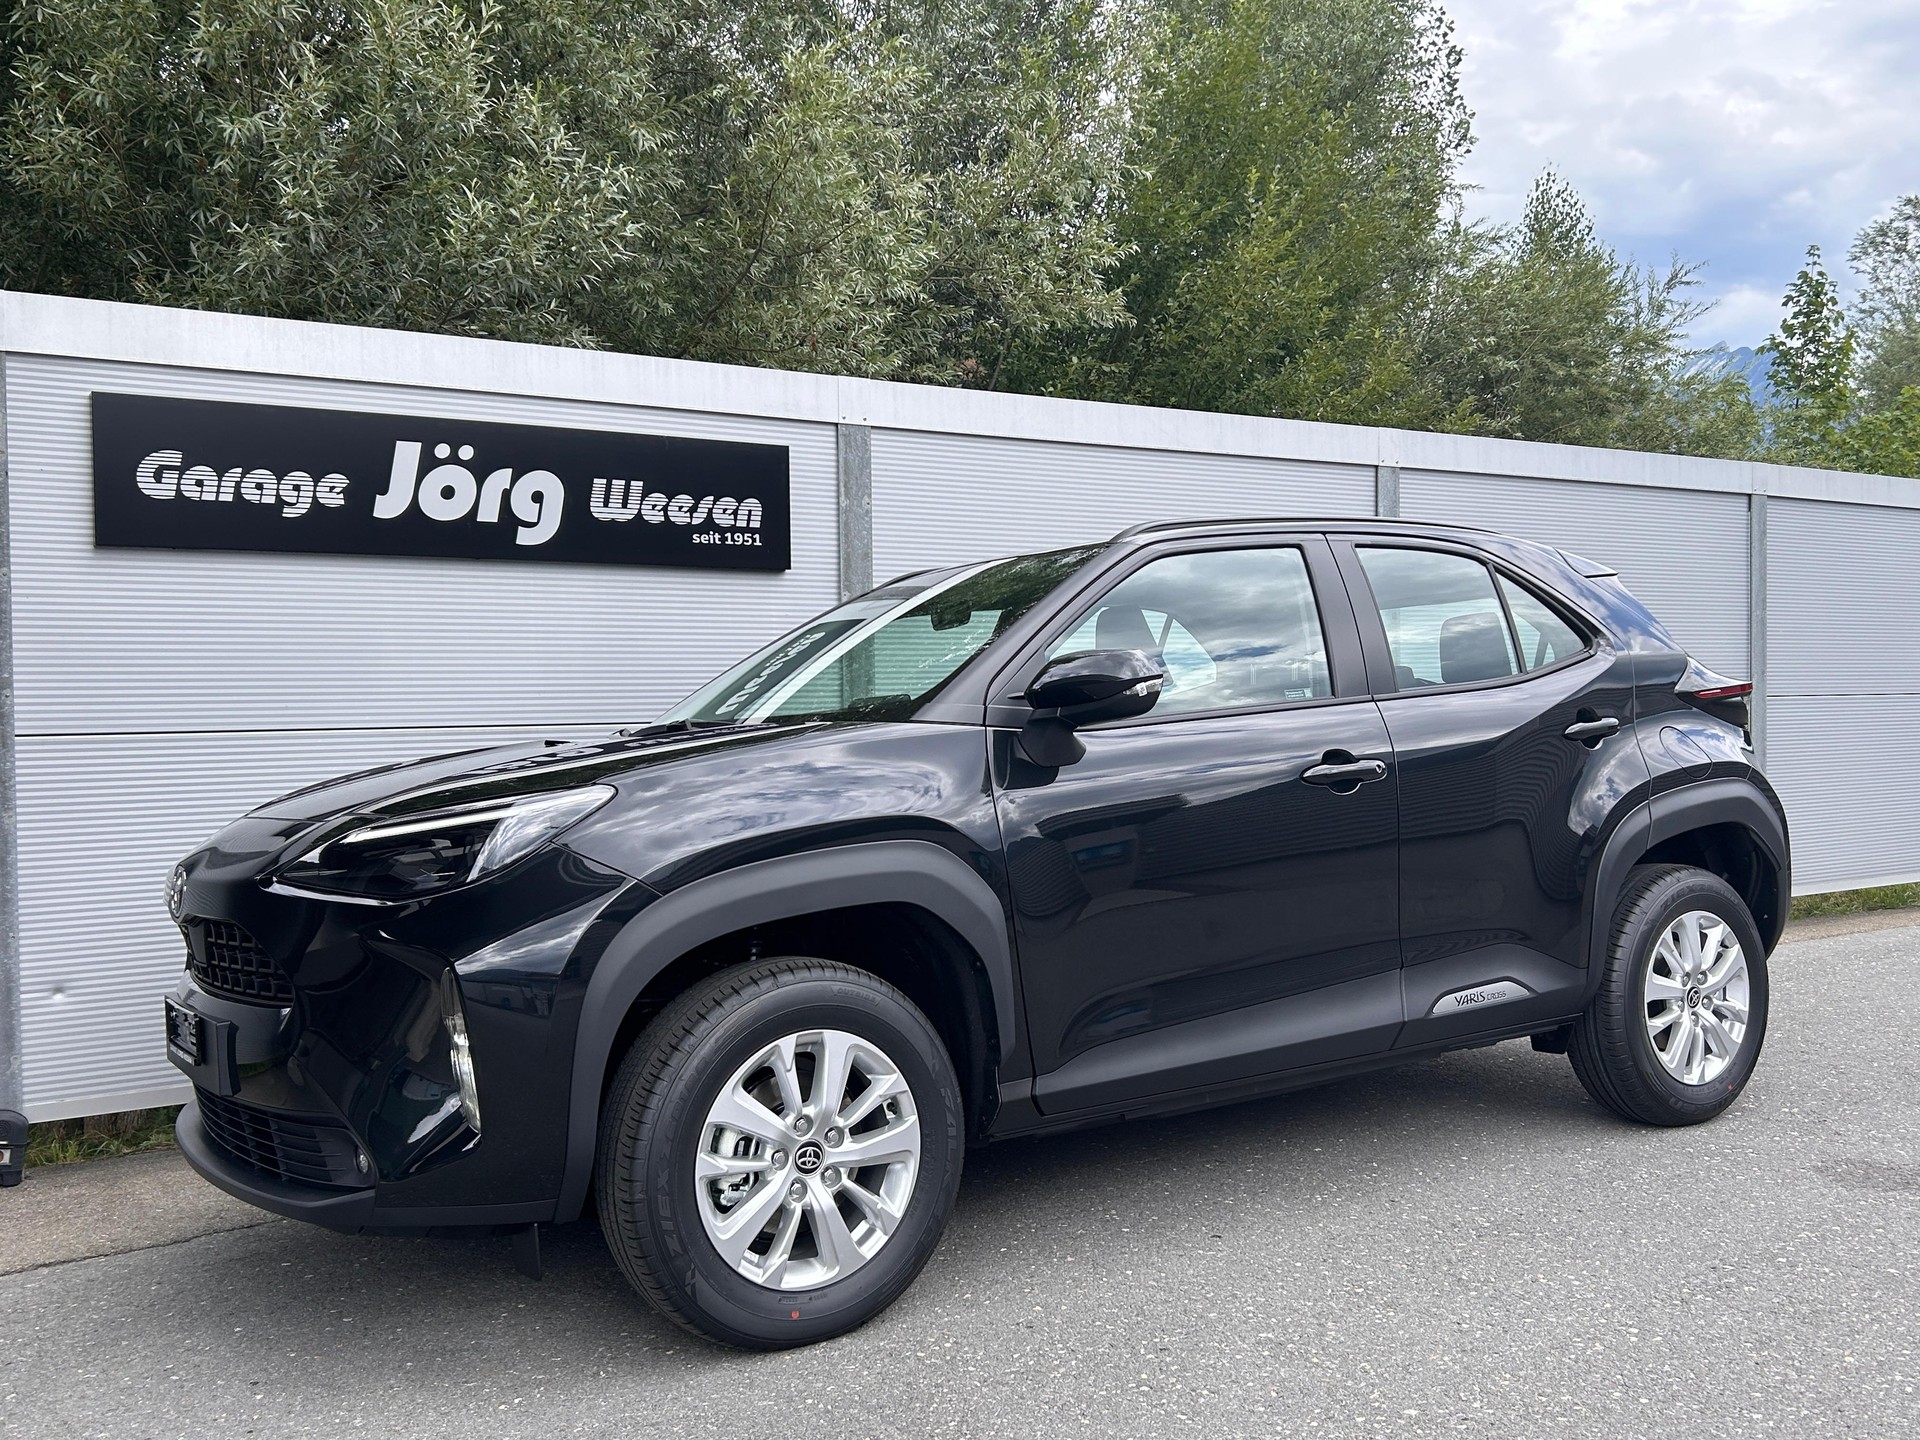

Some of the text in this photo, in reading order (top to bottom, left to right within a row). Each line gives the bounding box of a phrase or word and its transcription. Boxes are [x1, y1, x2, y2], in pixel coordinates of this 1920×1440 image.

[136, 440, 763, 546] Garage Jörg Weesen
[692, 531, 763, 546] seit 1951
[1486, 990, 1507, 1001] CROSS
